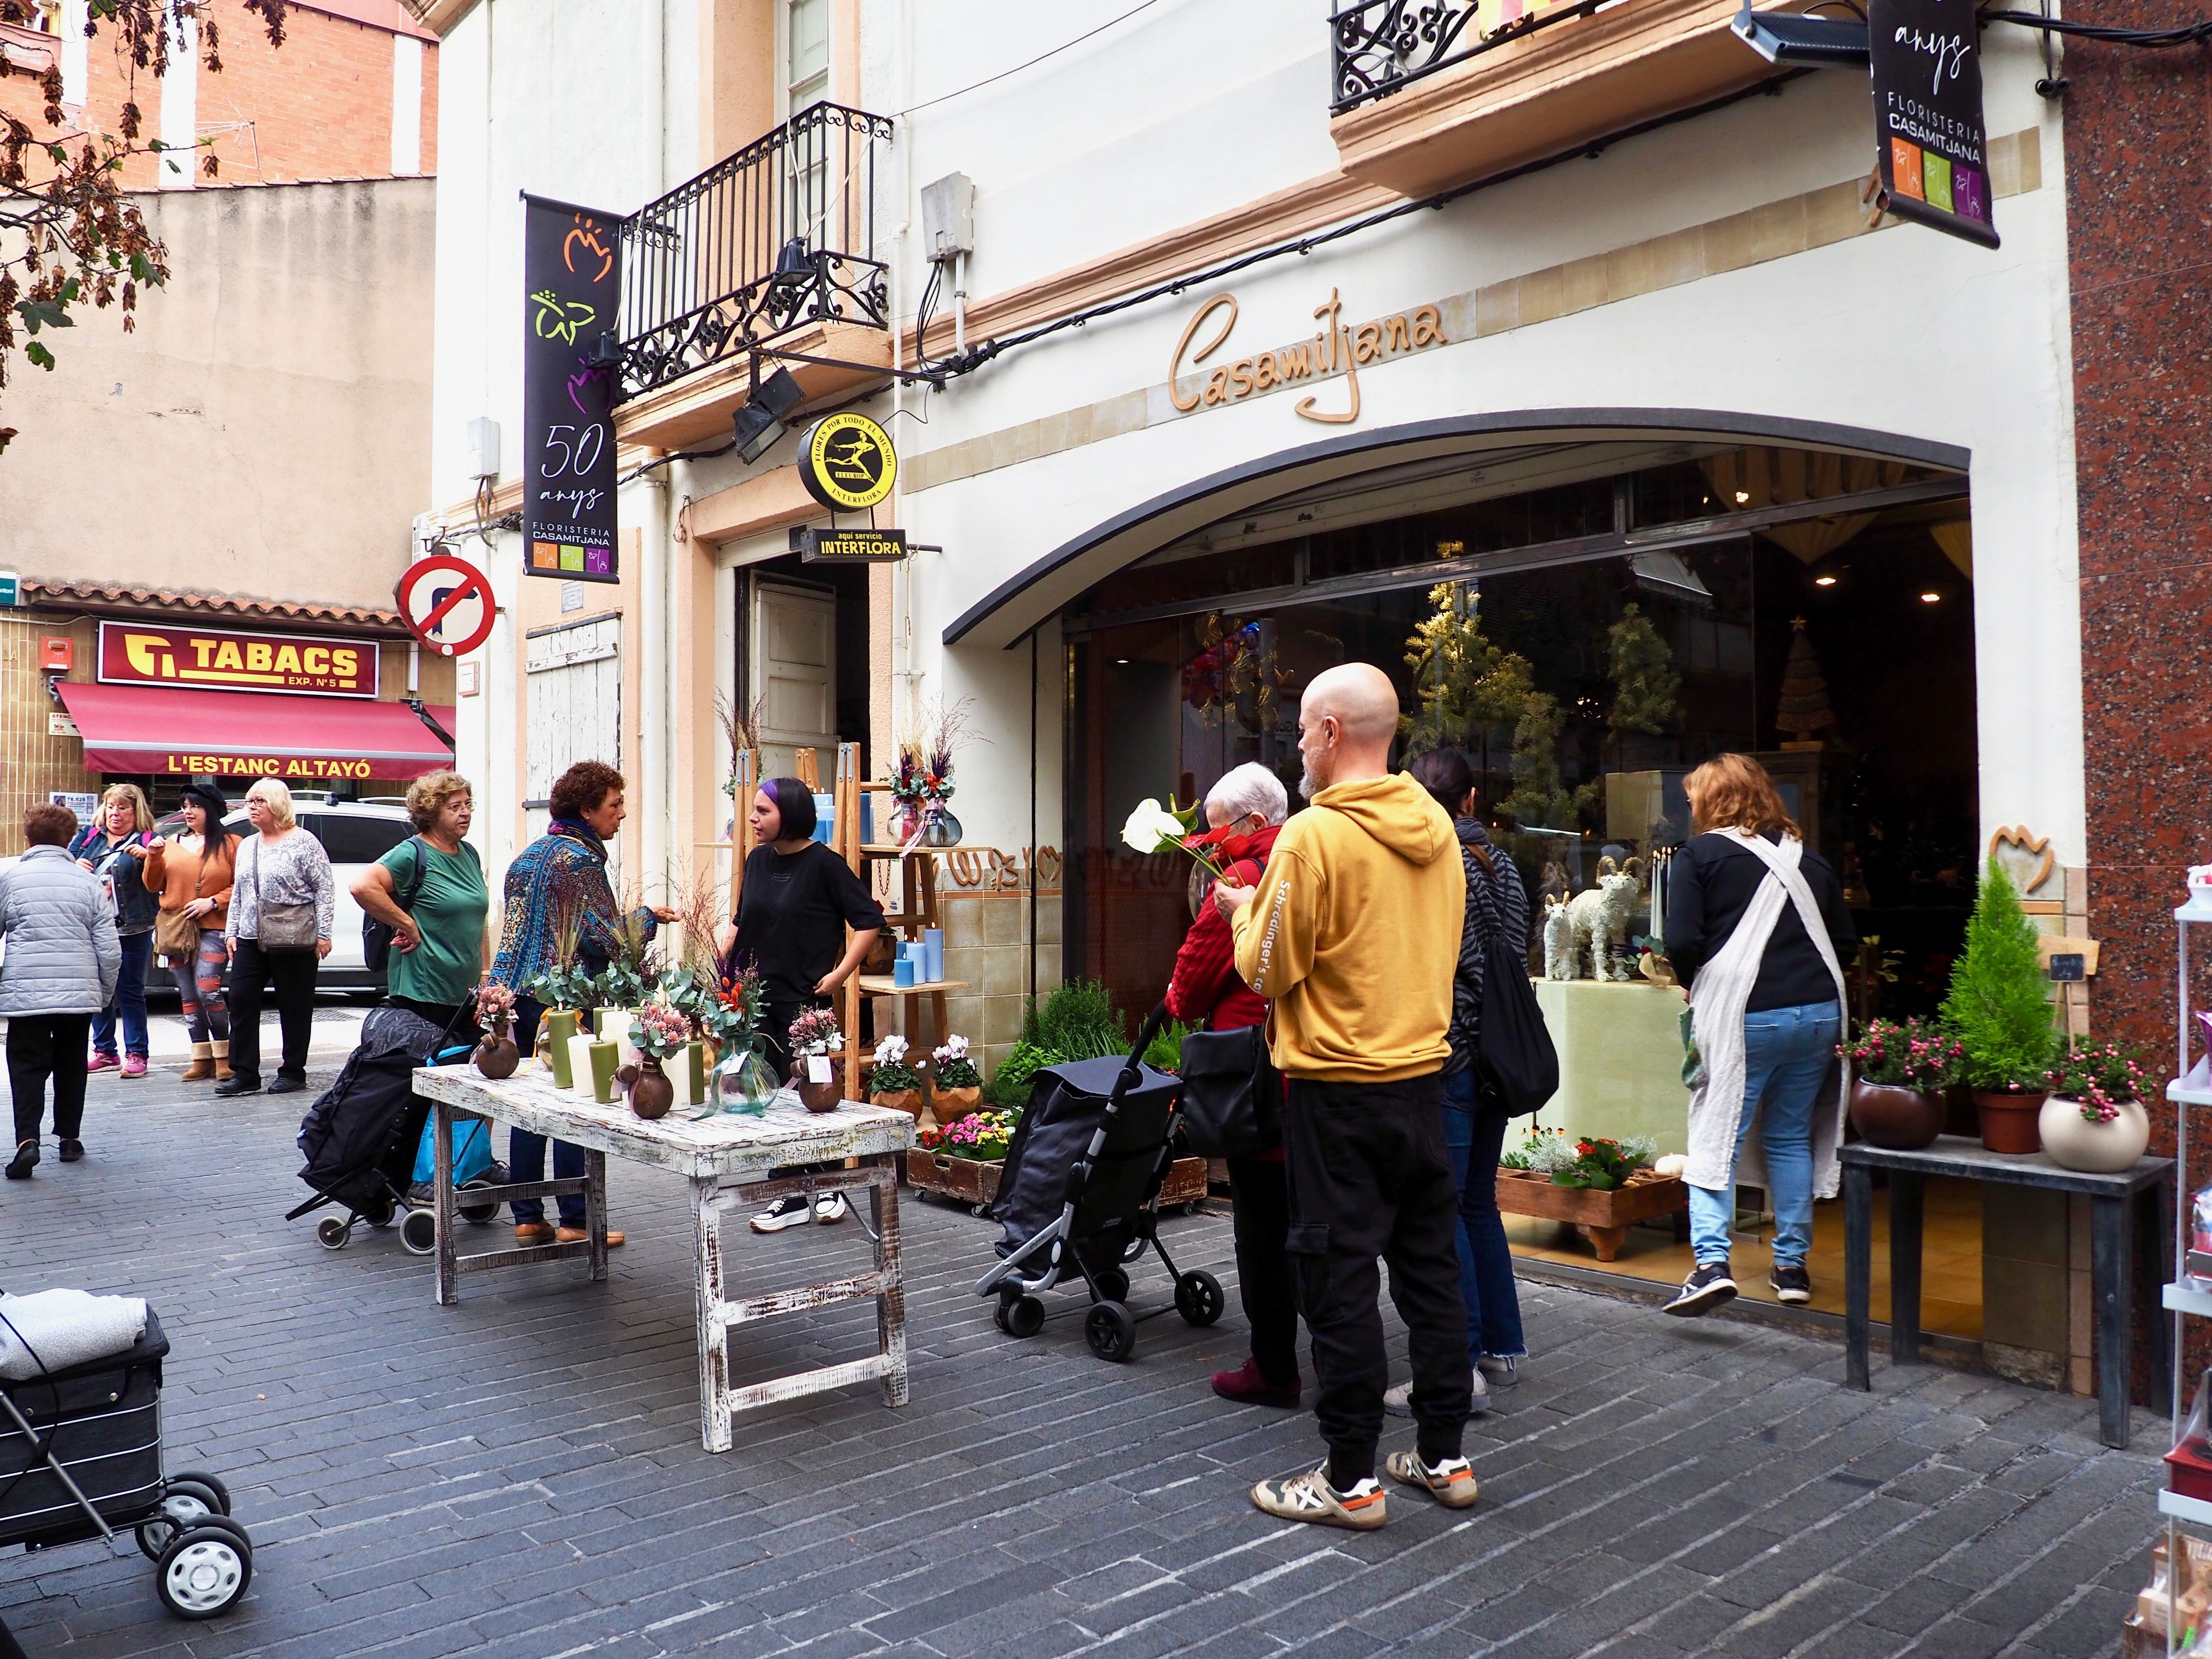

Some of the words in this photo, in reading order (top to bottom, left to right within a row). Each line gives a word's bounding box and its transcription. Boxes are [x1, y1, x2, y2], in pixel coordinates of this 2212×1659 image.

[1895, 25, 1971, 96] anys
[1888, 91, 1980, 144] FLORISTERIA
[1889, 113, 1981, 165] CASAMITJANA
[1168, 287, 1449, 423] Casamitjana
[541, 423, 604, 478] 50
[816, 430, 827, 461] FLORES
[827, 419, 841, 430] POR
[843, 417, 865, 426] TODO
[867, 424, 876, 434] EL
[878, 436, 892, 466] MUNDO
[540, 488, 604, 519] anys
[832, 488, 882, 503] INTERFLORA
[533, 521, 611, 537] FLORISTERIA
[533, 531, 610, 546] CASAMITJANA
[821, 541, 902, 554] INTERFLORA
[190, 638, 357, 676] TABACS
[289, 676, 312, 686] EXP.
[168, 756, 279, 774] L'ESTANC
[286, 758, 371, 778] ALTAYÓ
[1258, 880, 1290, 974] Schrödinger's
